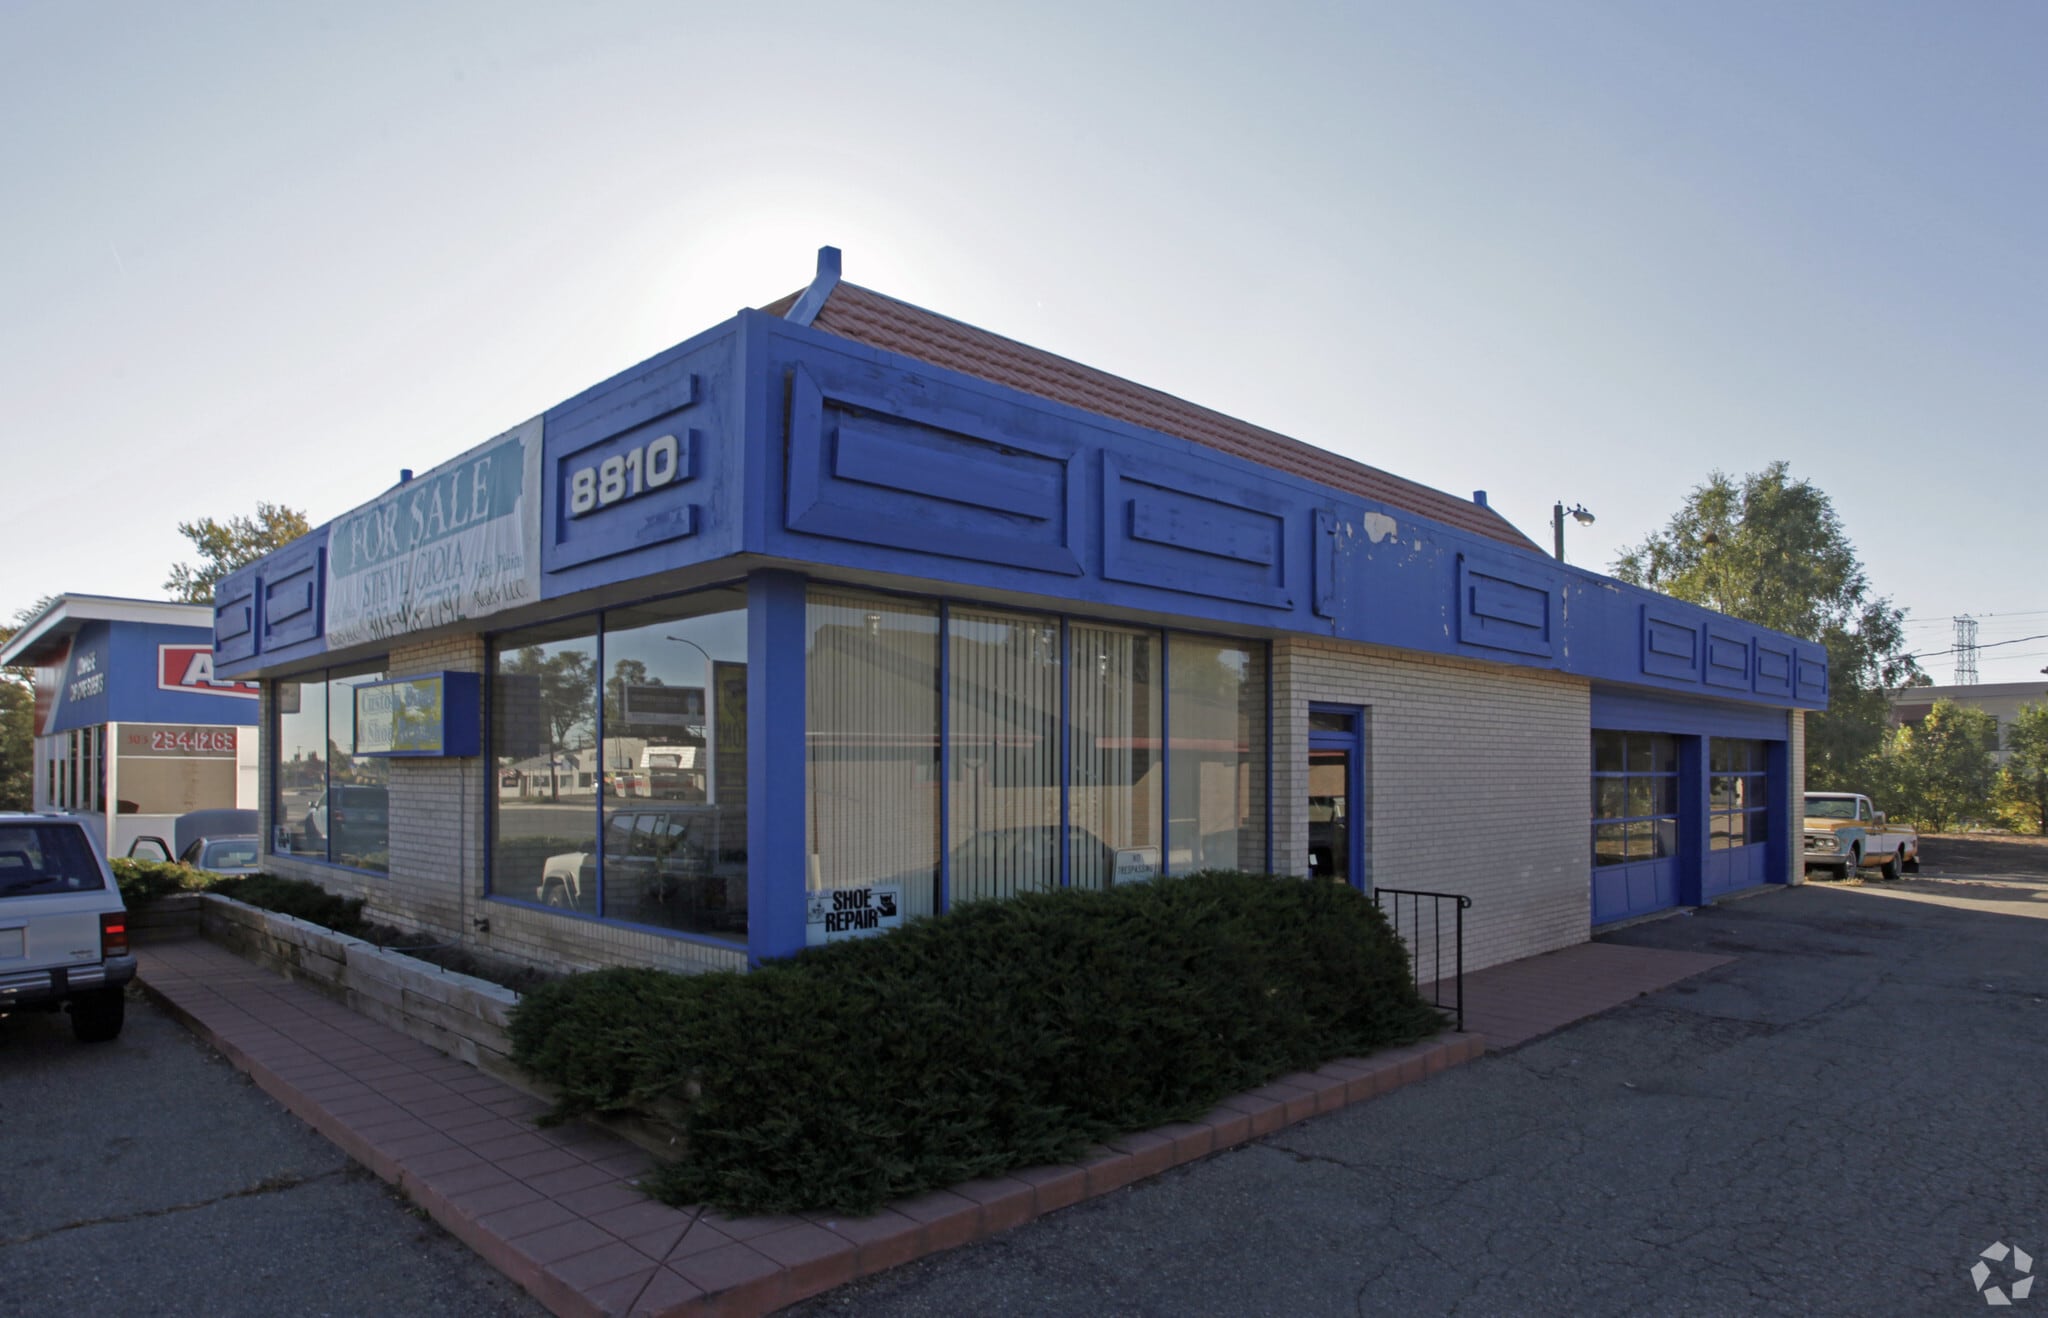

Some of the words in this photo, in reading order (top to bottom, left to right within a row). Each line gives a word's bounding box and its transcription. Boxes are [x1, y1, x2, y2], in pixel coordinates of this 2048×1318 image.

[571, 434, 680, 515] 8810
[350, 506, 400, 569] FOR
[411, 457, 491, 546] SALE
[363, 559, 410, 607] STEVE
[1132, 853, 1142, 862] NO
[833, 888, 872, 911] SHOE
[825, 909, 879, 933] REPAIR
